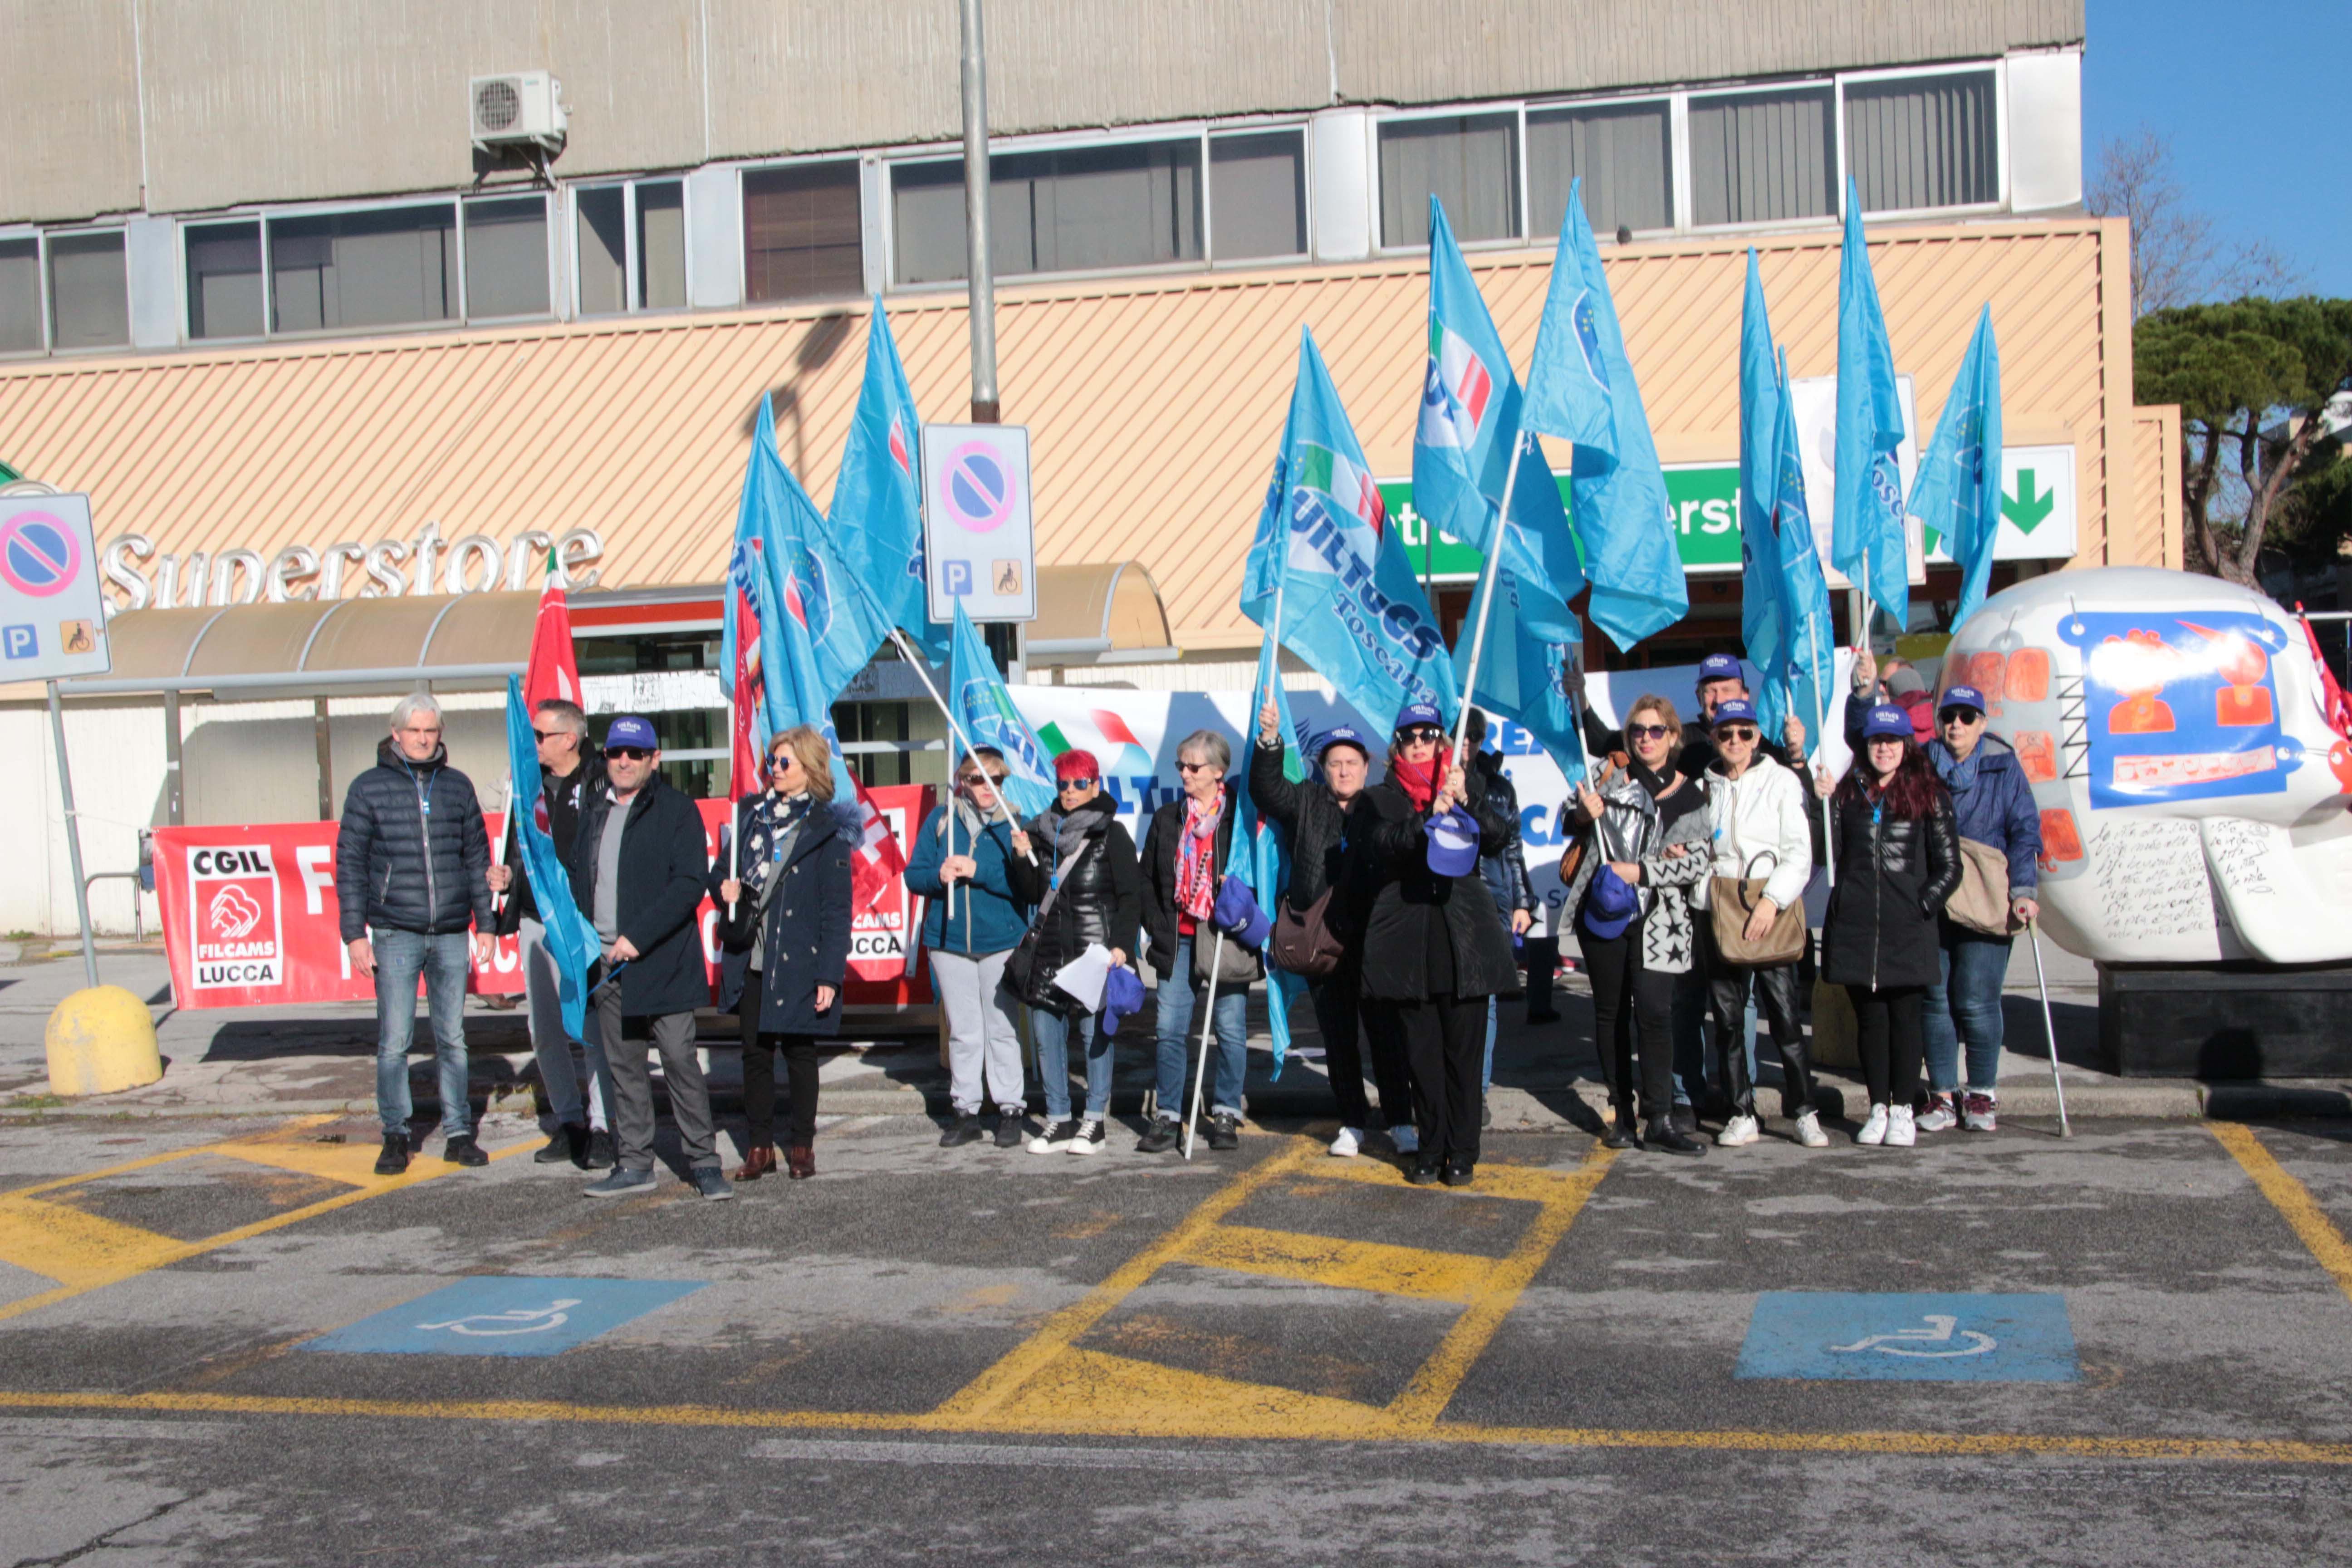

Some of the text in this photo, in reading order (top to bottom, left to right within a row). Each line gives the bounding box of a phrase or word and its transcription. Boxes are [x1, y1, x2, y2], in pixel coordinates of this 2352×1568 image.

[103, 520, 605, 618] Superstore
[949, 568, 966, 593] P
[10, 628, 32, 656] P
[1332, 590, 1439, 706] Toscana
[193, 851, 270, 874] CGIL
[852, 911, 901, 929] CAMS
[199, 940, 274, 959] FILCAMS
[200, 965, 273, 984] LUCCA
